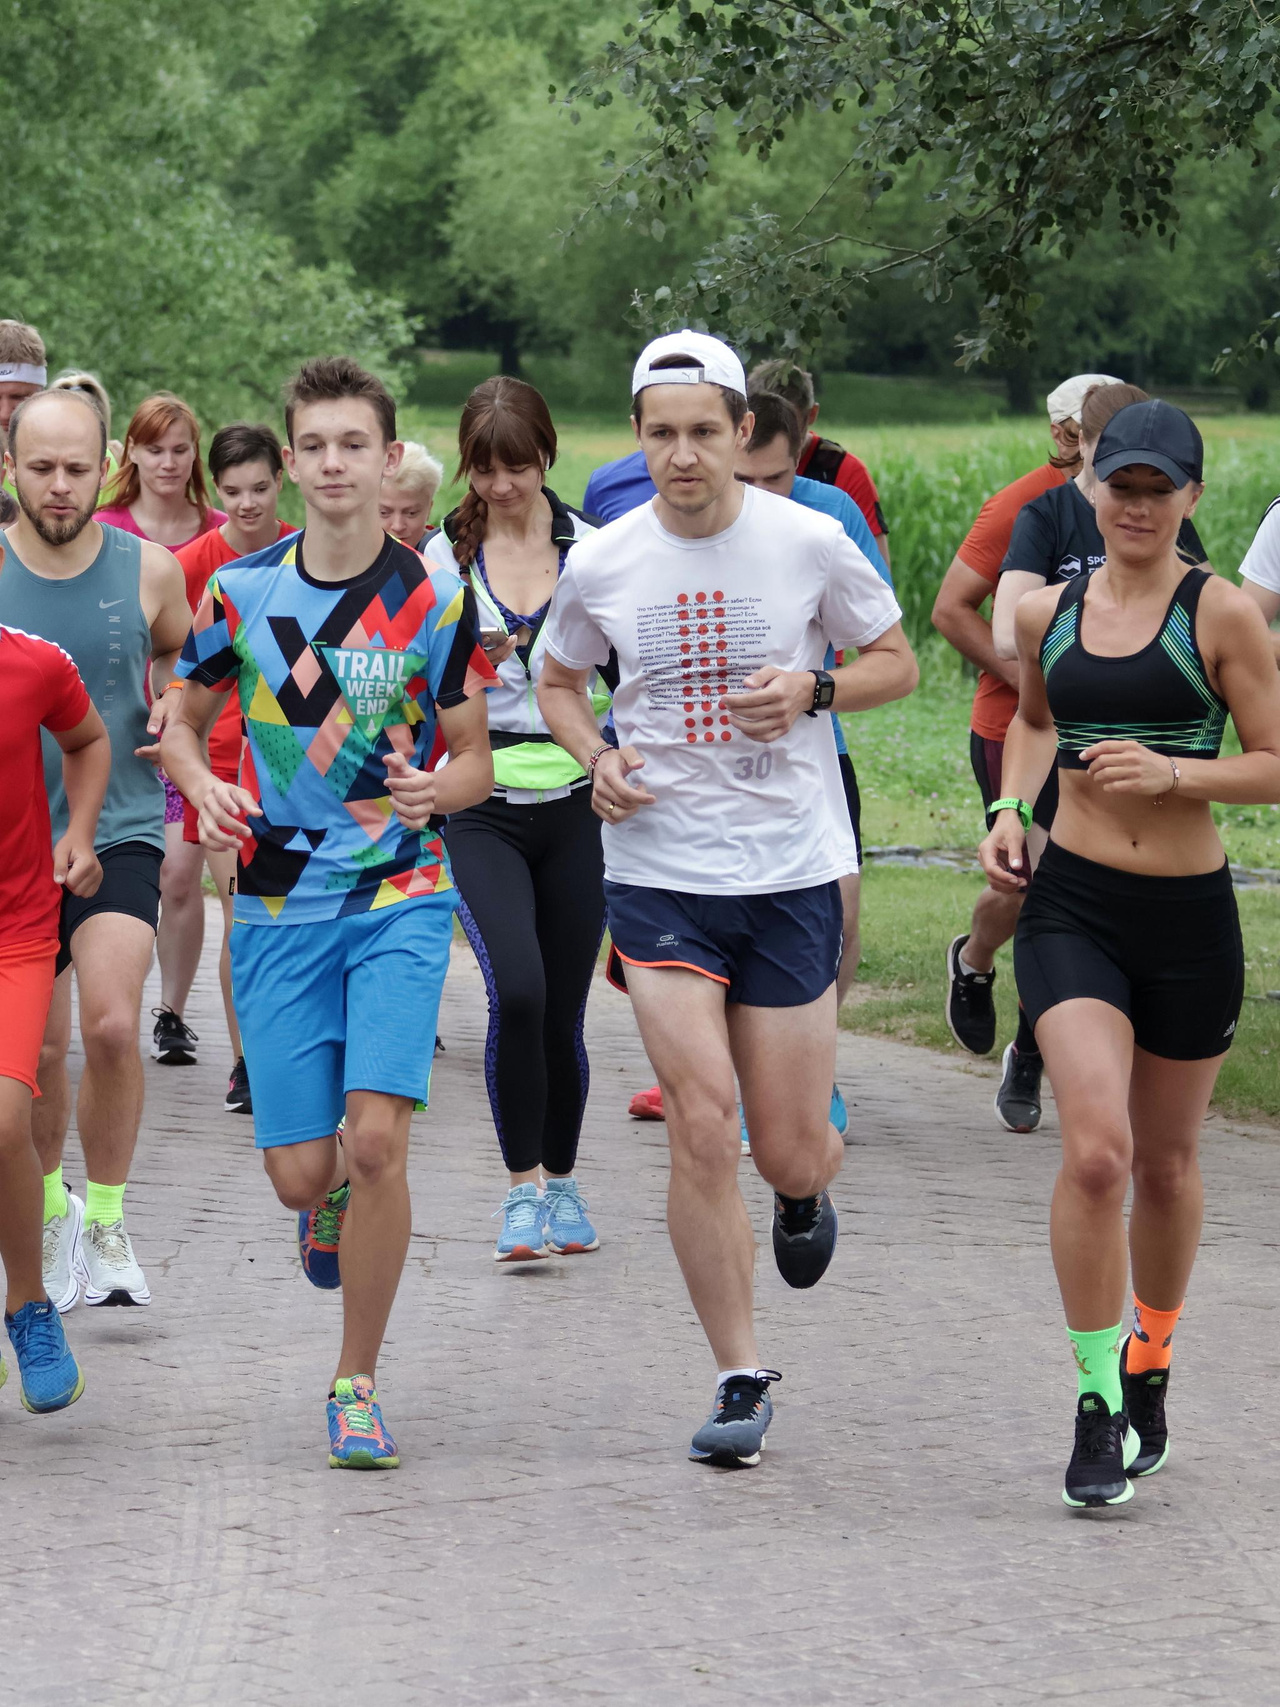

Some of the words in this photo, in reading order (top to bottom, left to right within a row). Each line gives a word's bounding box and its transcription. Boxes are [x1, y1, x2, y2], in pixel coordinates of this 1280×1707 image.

[108, 615, 121, 665] NIKE
[335, 651, 407, 682] TRAIL
[346, 680, 397, 698] WEEK
[356, 699, 389, 716] END
[733, 751, 772, 781] 30
